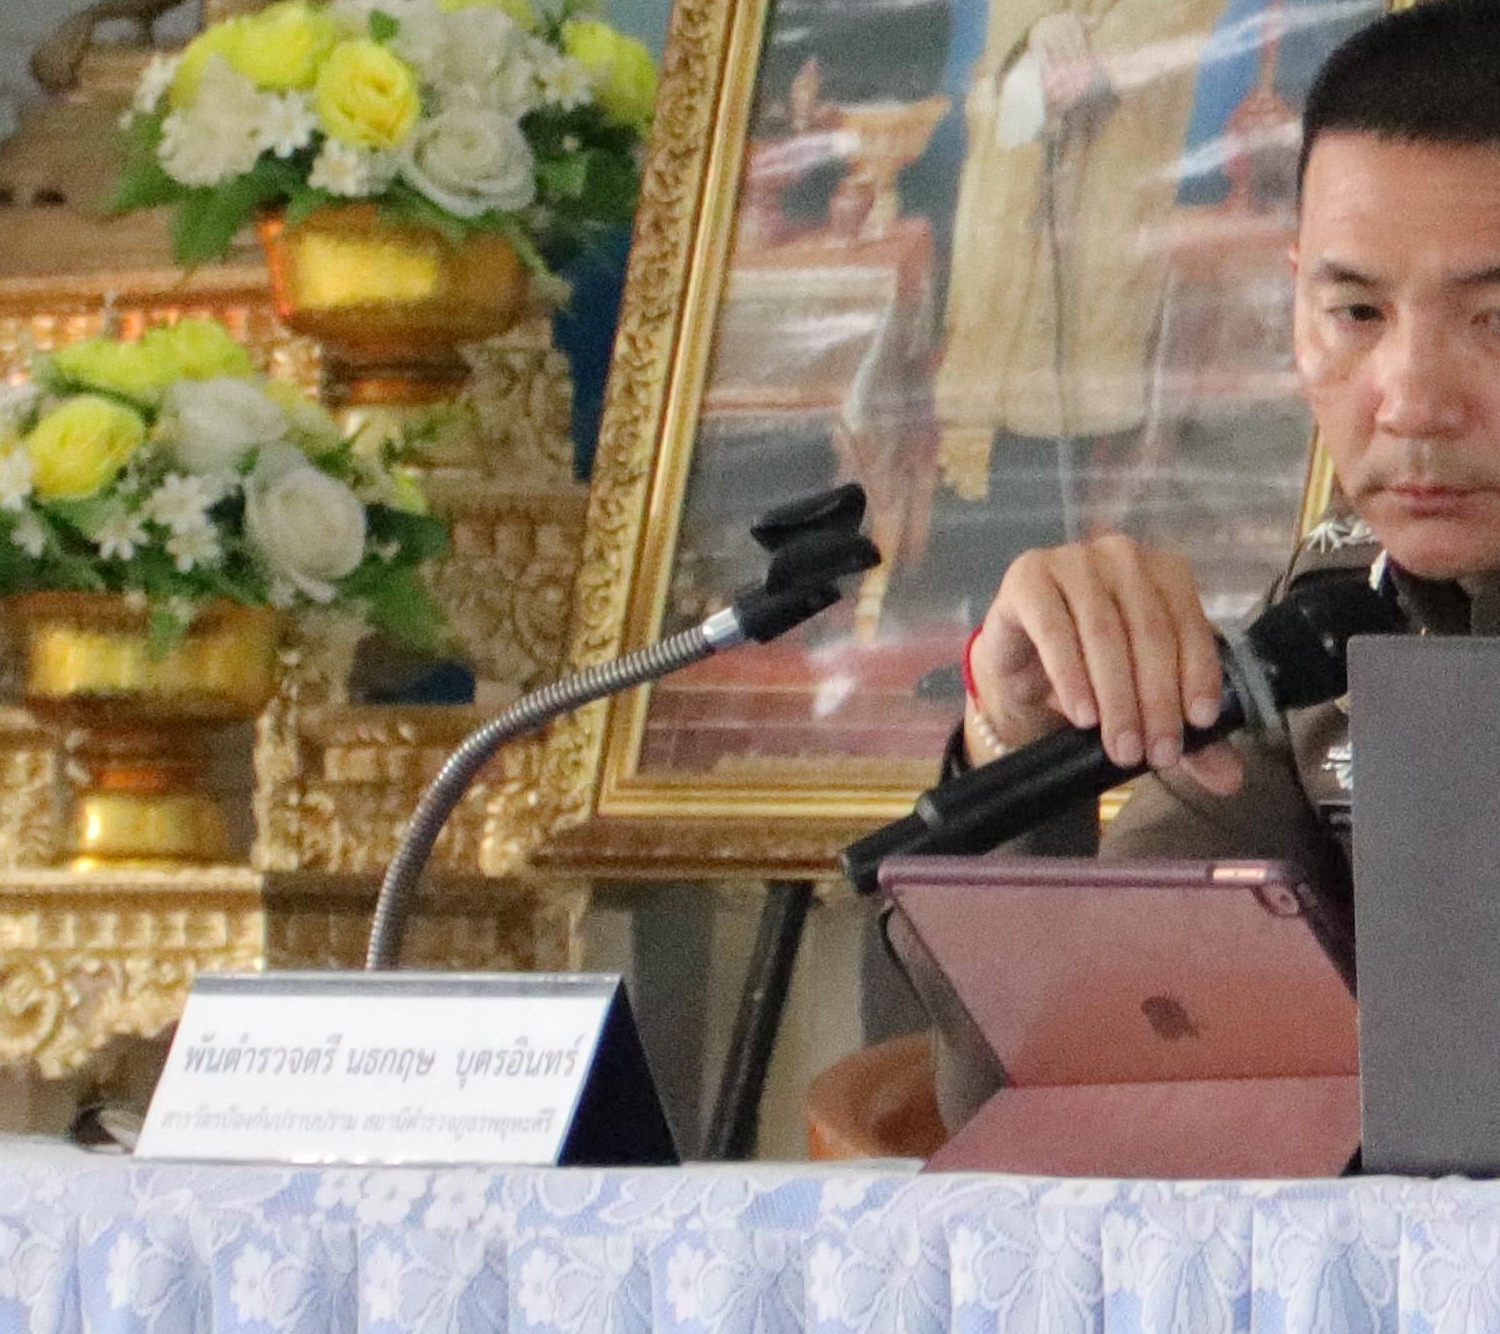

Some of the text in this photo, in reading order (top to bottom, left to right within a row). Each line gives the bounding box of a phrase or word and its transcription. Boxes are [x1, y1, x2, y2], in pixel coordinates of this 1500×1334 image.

[183, 1032, 343, 1075] พันตำรวจตรี
[456, 1033, 585, 1089] บุตรอินทร์
